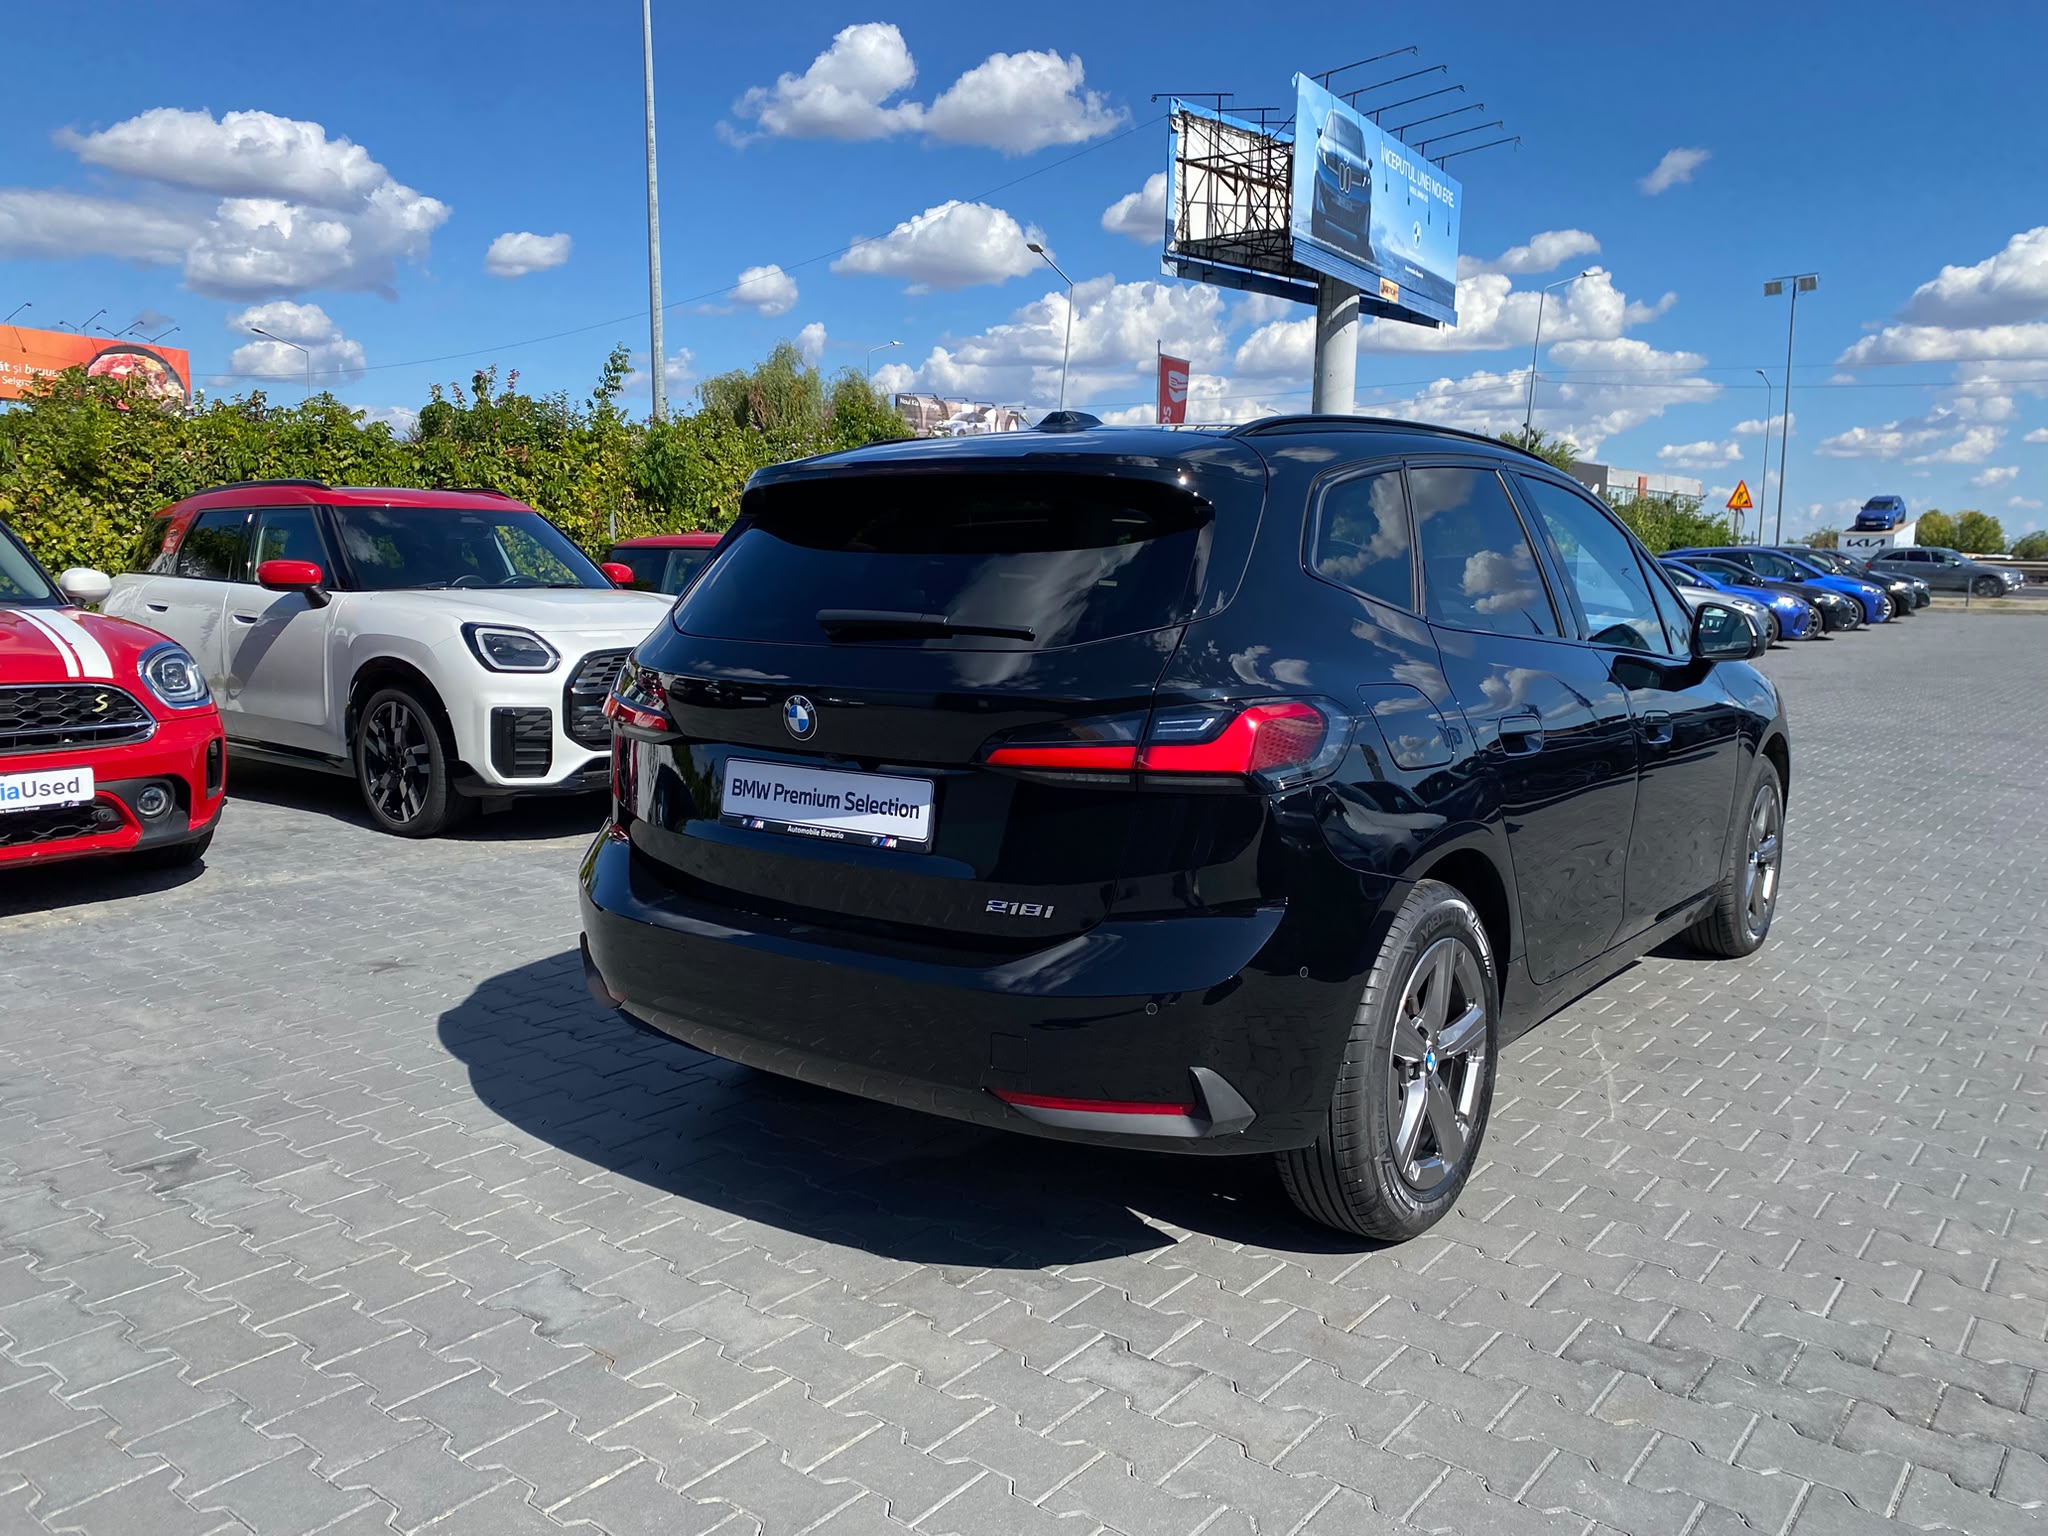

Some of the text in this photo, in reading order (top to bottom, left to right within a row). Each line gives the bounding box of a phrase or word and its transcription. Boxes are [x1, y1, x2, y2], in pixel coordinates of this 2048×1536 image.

[1443, 186, 1455, 209] ERE
[1847, 539, 1886, 548] KIA
[92, 694, 108, 712] S
[731, 778, 920, 820] BMW Premium Selection
[787, 825, 844, 840] Automobile Bavaria
